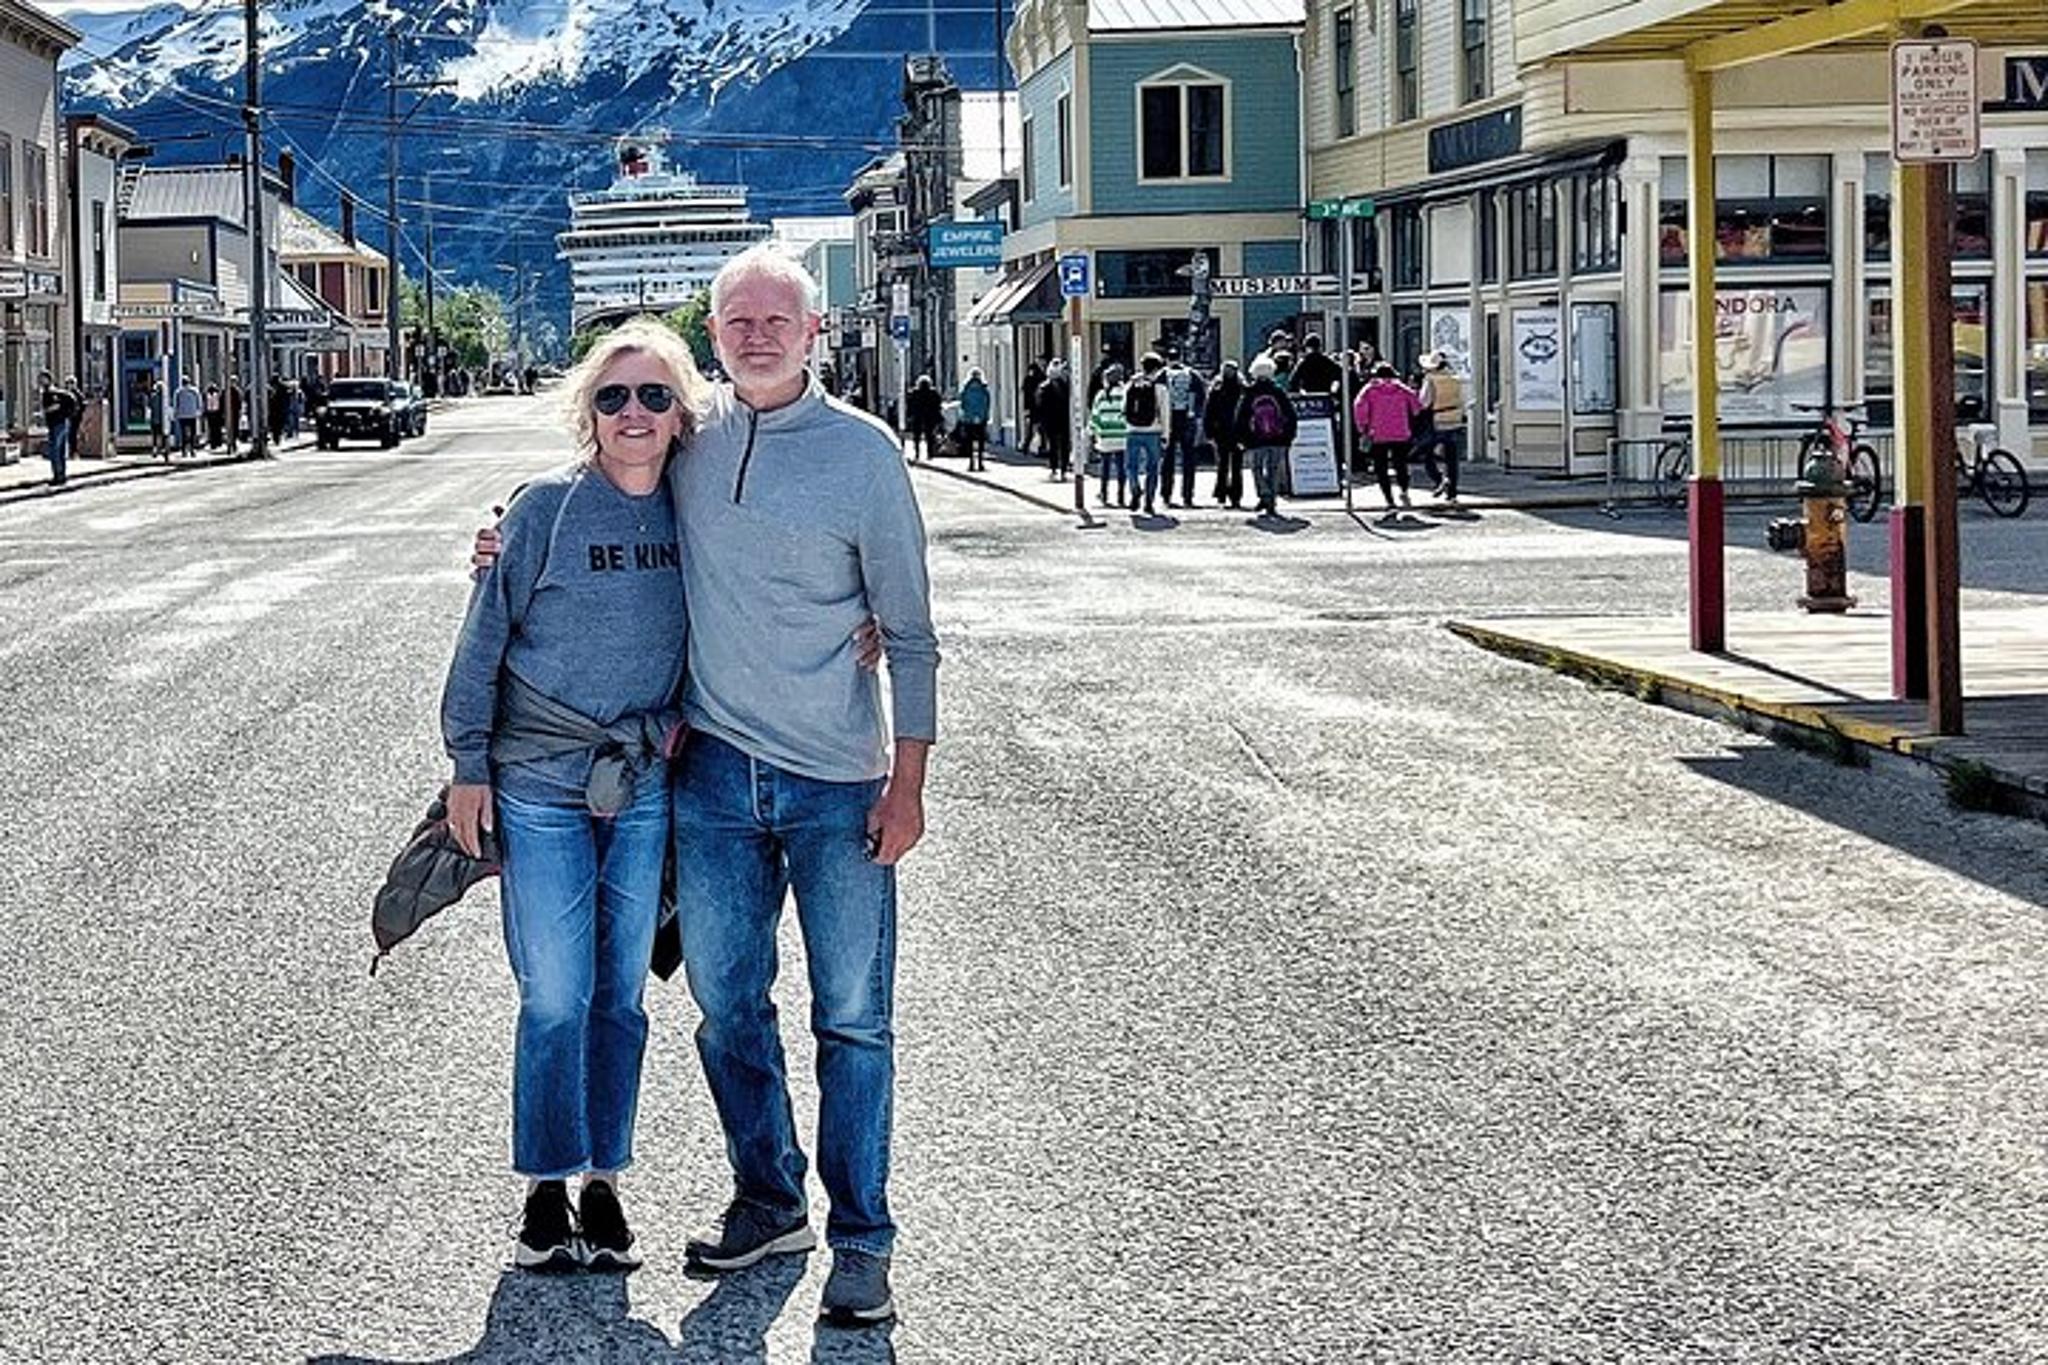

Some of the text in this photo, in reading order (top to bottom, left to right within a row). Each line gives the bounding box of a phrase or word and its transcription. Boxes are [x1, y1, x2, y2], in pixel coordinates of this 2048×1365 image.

[1920, 51, 1963, 64] HOUR
[1901, 62, 1968, 77] PARKING
[1914, 77, 1955, 91] ONLY
[942, 230, 993, 242] EMPIRE
[1211, 277, 1312, 294] MUSEUM
[1715, 297, 1798, 314] NDORA
[589, 543, 680, 571] BE KIN
